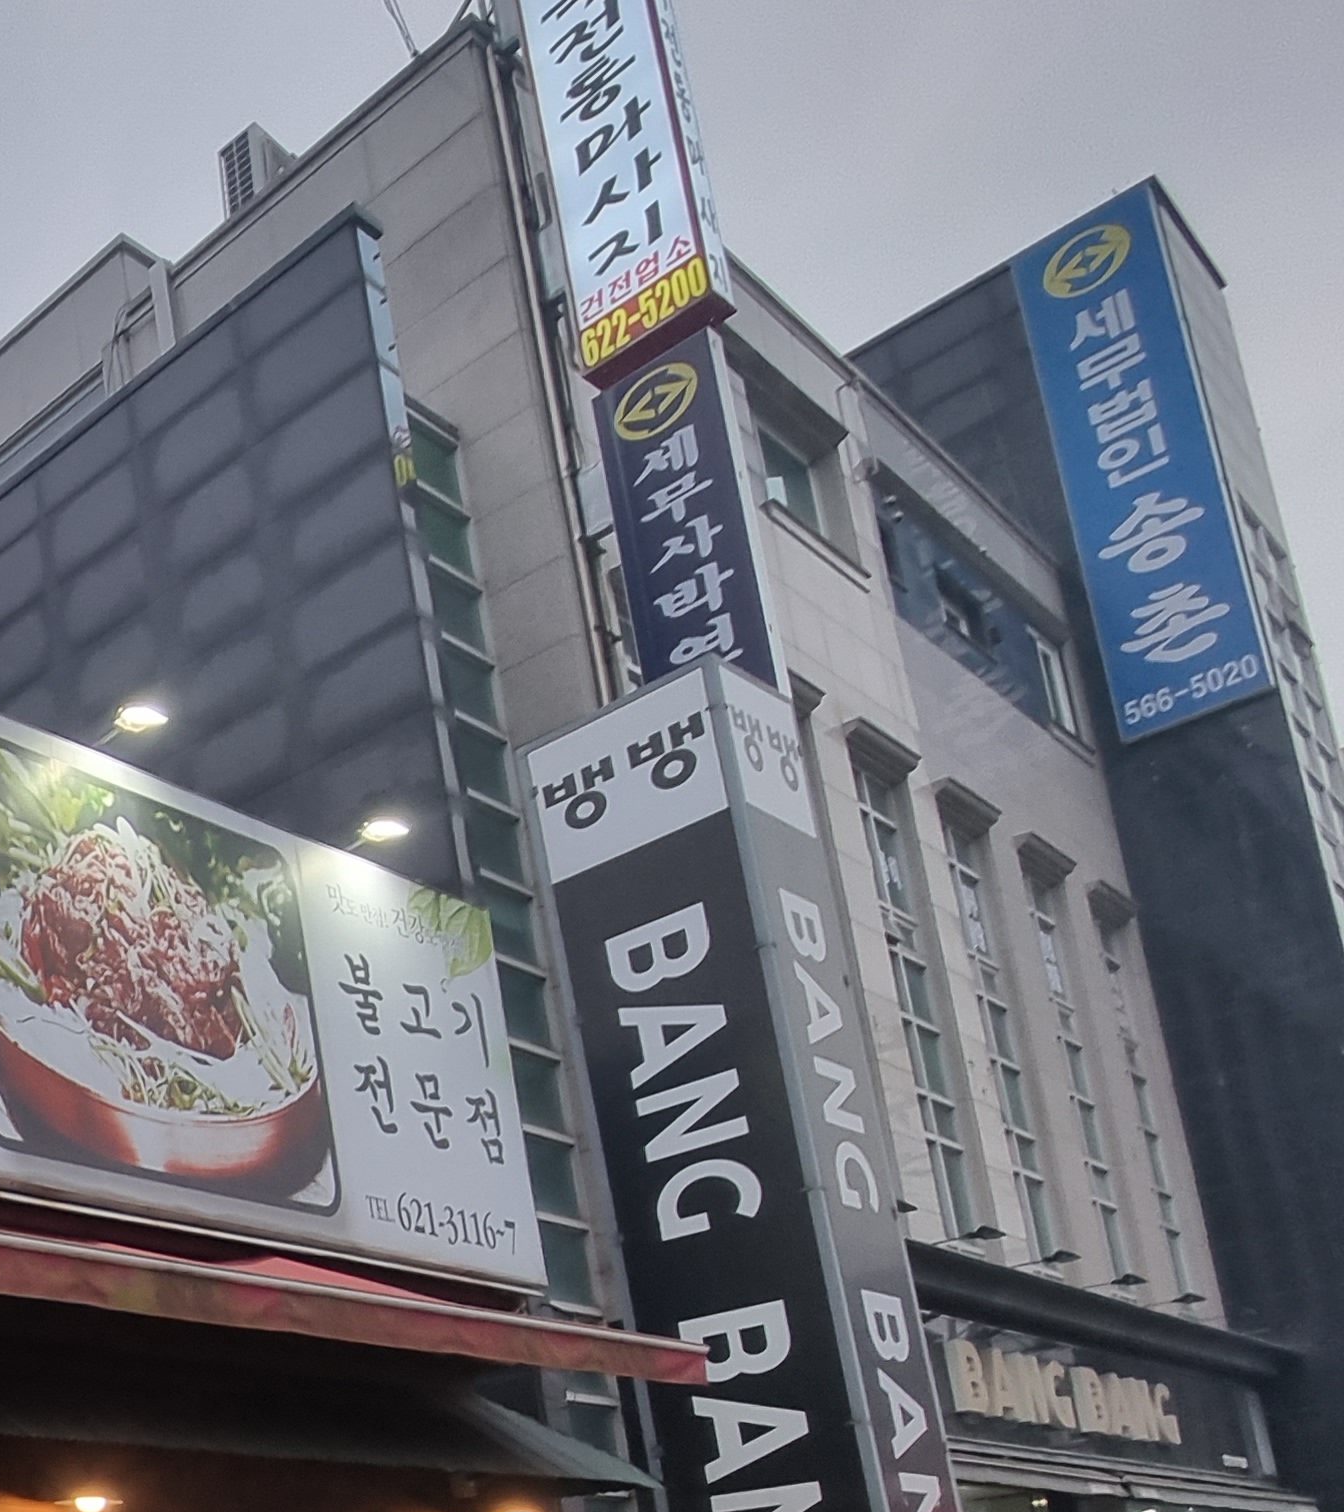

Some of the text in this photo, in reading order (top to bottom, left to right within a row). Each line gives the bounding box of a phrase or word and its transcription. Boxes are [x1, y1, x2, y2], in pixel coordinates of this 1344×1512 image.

[540, 0, 663, 277] 전통마사지
[580, 235, 692, 323] 건전업소
[580, 255, 708, 368] 622-5200
[1070, 288, 1170, 489] 세무법인
[1123, 653, 1260, 725] 566-5020
[541, 709, 707, 830] 뱅뱅
[338, 952, 490, 1069] 불고기
[776, 884, 882, 1218] BANG
[354, 1055, 505, 1165] 전문점
[602, 900, 765, 1243] BANG
